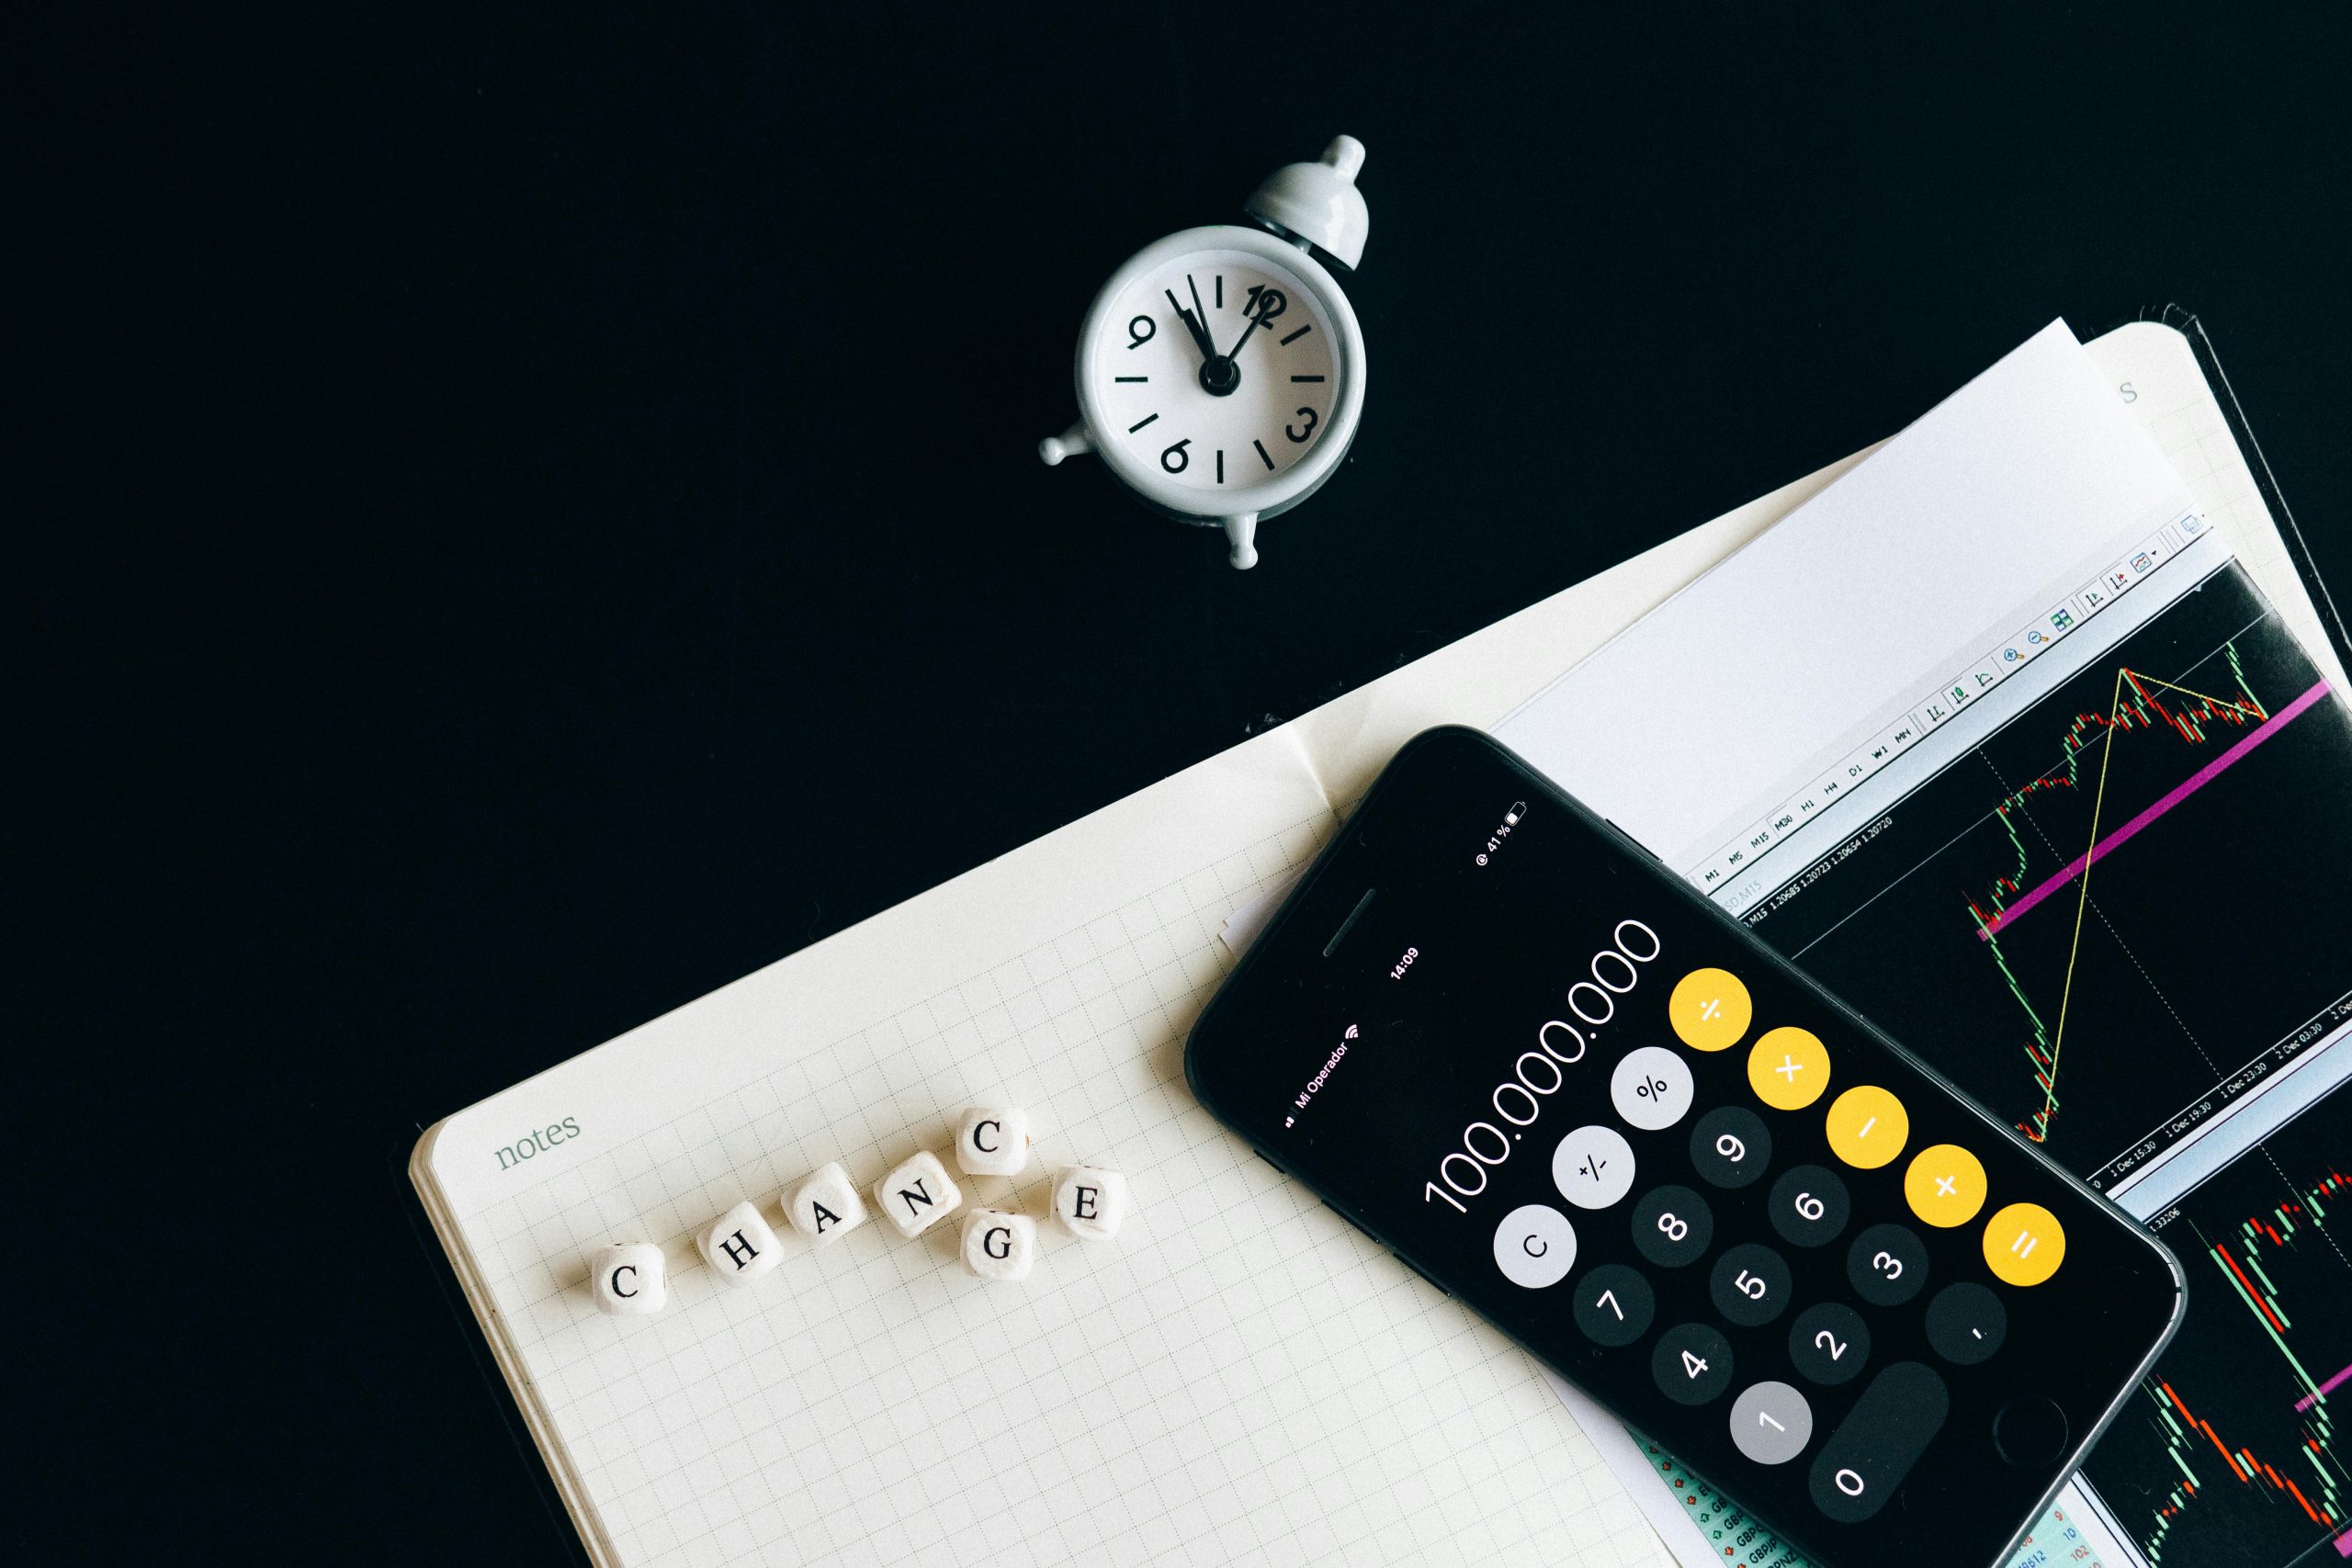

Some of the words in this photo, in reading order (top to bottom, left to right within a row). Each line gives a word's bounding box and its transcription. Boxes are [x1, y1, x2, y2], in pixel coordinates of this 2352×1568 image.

[1242, 284, 1287, 331] 12
[1127, 314, 1157, 351] 9
[1285, 406, 1318, 444] 3
[1160, 438, 1192, 474] 6
[1705, 869, 1720, 883] M1
[1728, 851, 1743, 865] M5
[1750, 831, 1770, 850] M15
[1774, 815, 1792, 831] M30
[1801, 799, 1815, 812] H1
[1824, 782, 1838, 795] H4
[1849, 764, 1863, 777] D1
[1871, 745, 1888, 760] W1
[1894, 728, 1912, 743] MN
[1487, 837, 1501, 852] 41
[1801, 862, 1832, 887] 1.20723
[1861, 817, 1893, 842] 1.20720
[1390, 947, 1419, 980] 14:09
[2275, 1051, 2283, 1059] 2
[2282, 1040, 2300, 1054] Dec
[2299, 1022, 2323, 1042] 03:30
[1295, 1091, 1311, 1109] Mi
[1306, 1042, 1348, 1093] Operador
[1425, 919, 1660, 1213] 100.000.000
[2227, 1079, 2245, 1093] Dec
[2243, 1062, 2267, 1082] 23:30
[2171, 1119, 2189, 1133] Dec
[2188, 1101, 2211, 1121] 19:30
[494, 1113, 581, 1171] notes
[2117, 1157, 2134, 1172] Dec
[2133, 1141, 2156, 1160] 15:30
[1522, 1234, 1548, 1258] C
[1596, 1289, 1624, 1321] 7
[1657, 1213, 1688, 1241] 8
[1715, 1134, 1746, 1162] 9
[1681, 1349, 1709, 1380] 4
[1735, 1269, 1766, 1300] 5
[1794, 1192, 1825, 1221] 6
[1758, 1411, 1786, 1433] 1
[1815, 1330, 1848, 1361] 2
[1872, 1251, 1903, 1280] 3
[1835, 1468, 1864, 1496] 0
